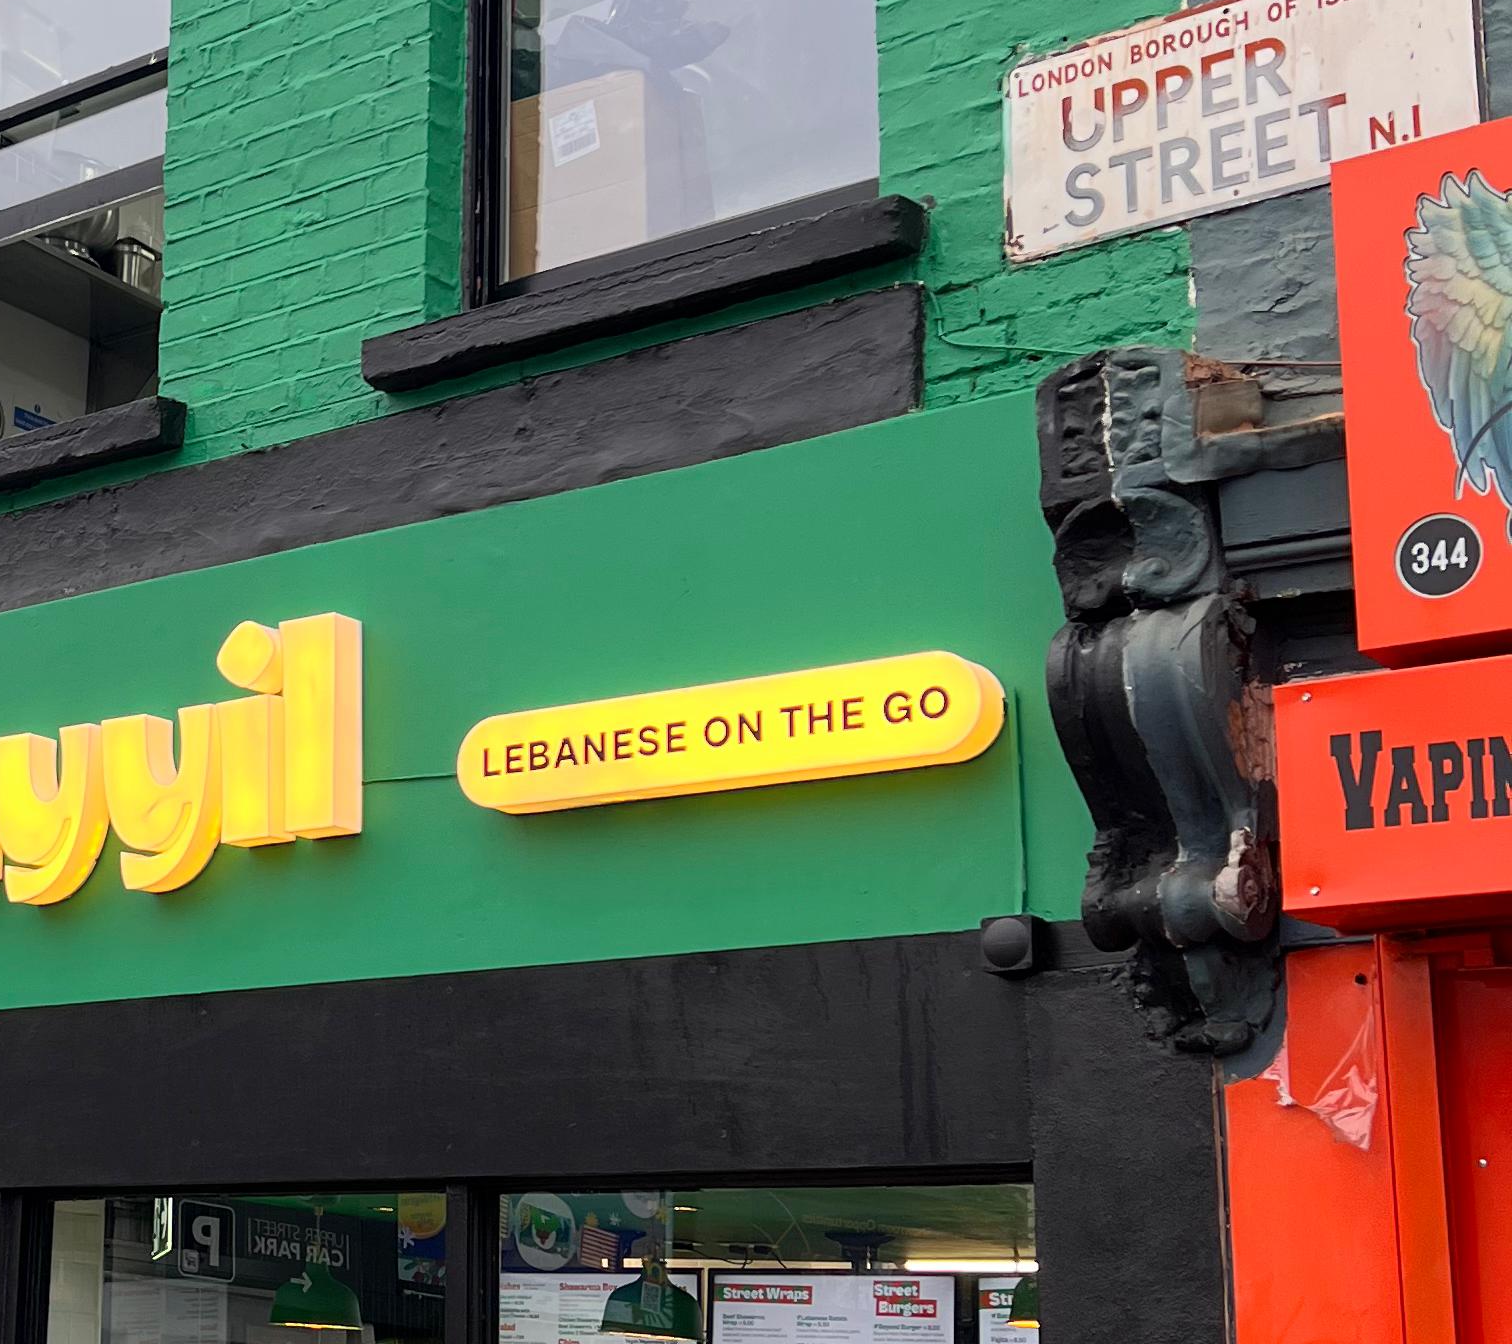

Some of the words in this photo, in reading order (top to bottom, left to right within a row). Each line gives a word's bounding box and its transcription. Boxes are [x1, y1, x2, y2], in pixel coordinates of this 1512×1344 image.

[1017, 52, 1113, 98] LONDON
[1130, 11, 1249, 62] BOROUGH
[1061, 37, 1292, 152] UPPER
[1064, 94, 1346, 227] STREET
[1411, 537, 1468, 575] 344
[482, 720, 687, 778] LEBANESE
[703, 710, 763, 748] ON
[780, 696, 865, 738] THE
[882, 685, 950, 724] GO
[723, 1287, 764, 1299] Street
[767, 1288, 809, 1302] Wraps
[874, 1284, 918, 1297] Street
[879, 1301, 935, 1316] Burgers
